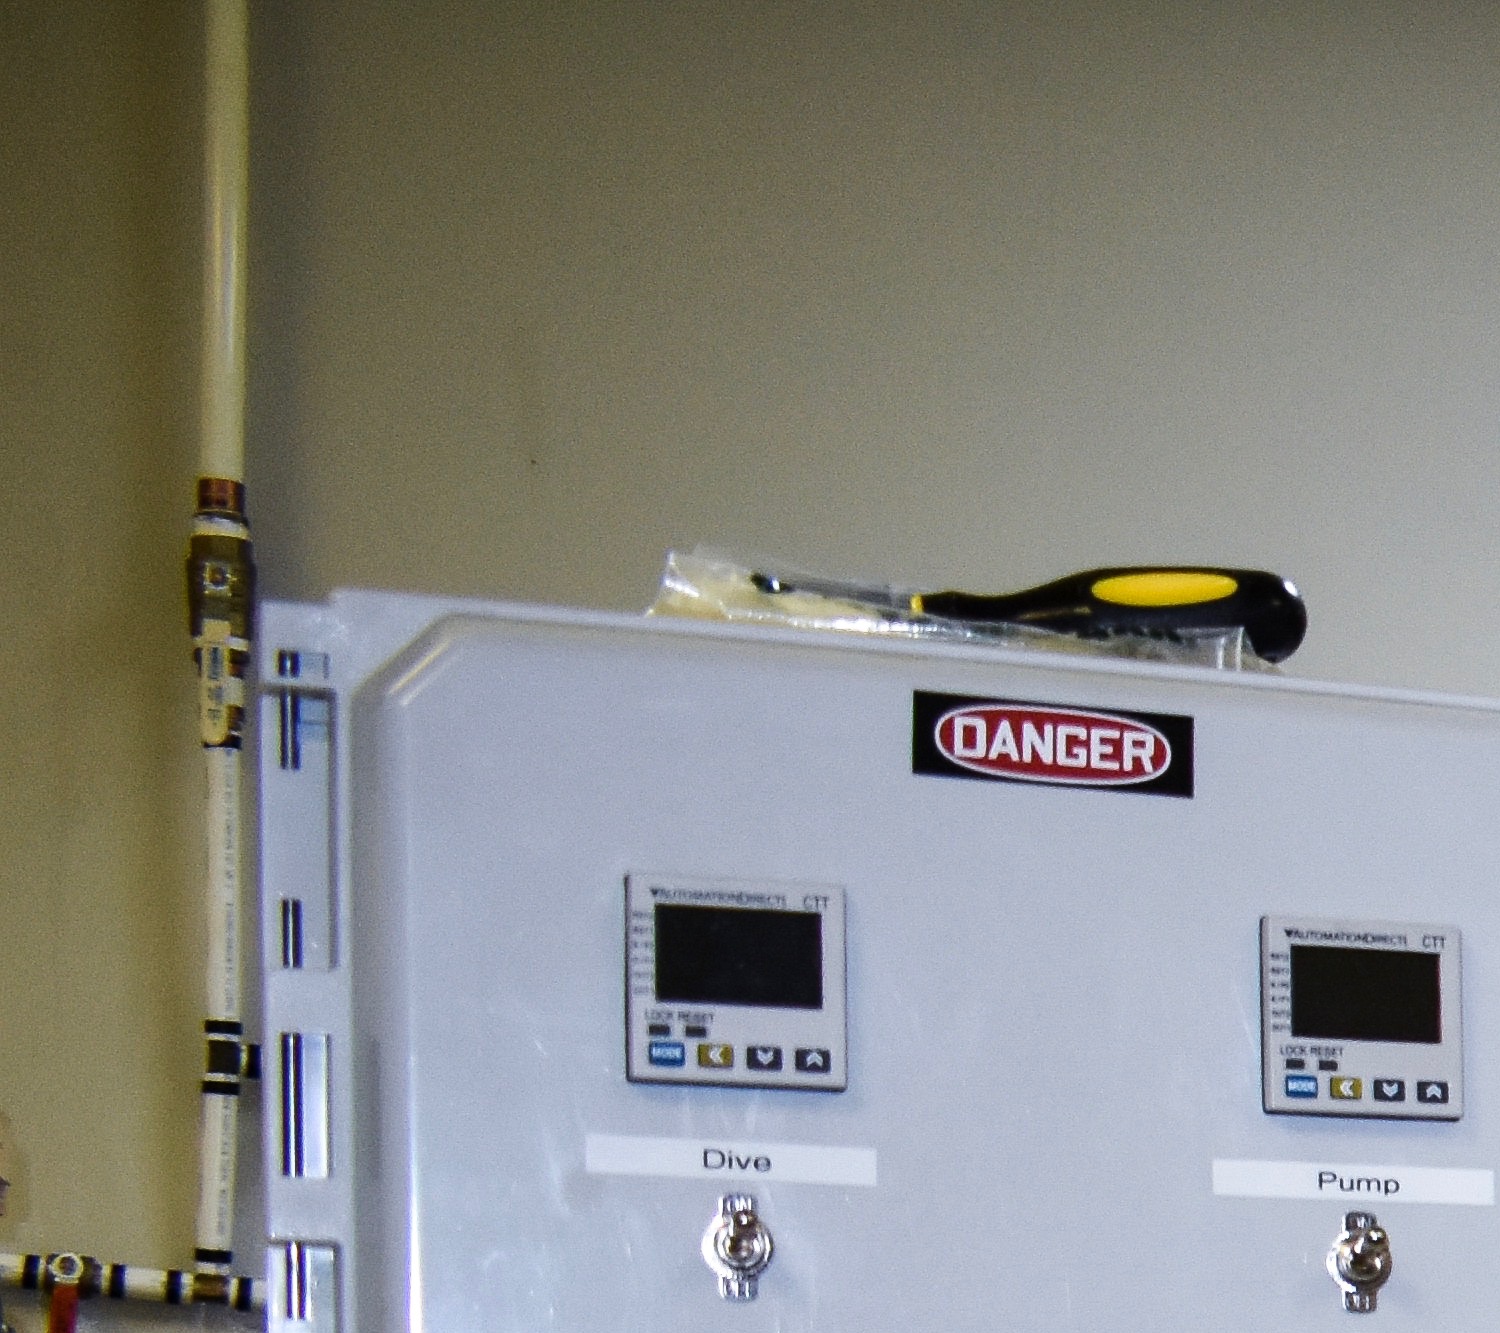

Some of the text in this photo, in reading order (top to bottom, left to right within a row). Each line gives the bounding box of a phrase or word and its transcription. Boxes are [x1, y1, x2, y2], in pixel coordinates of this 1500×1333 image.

[954, 717, 1155, 773] DANGER
[703, 1149, 771, 1172] Dive
[1318, 1171, 1400, 1195] Pump
